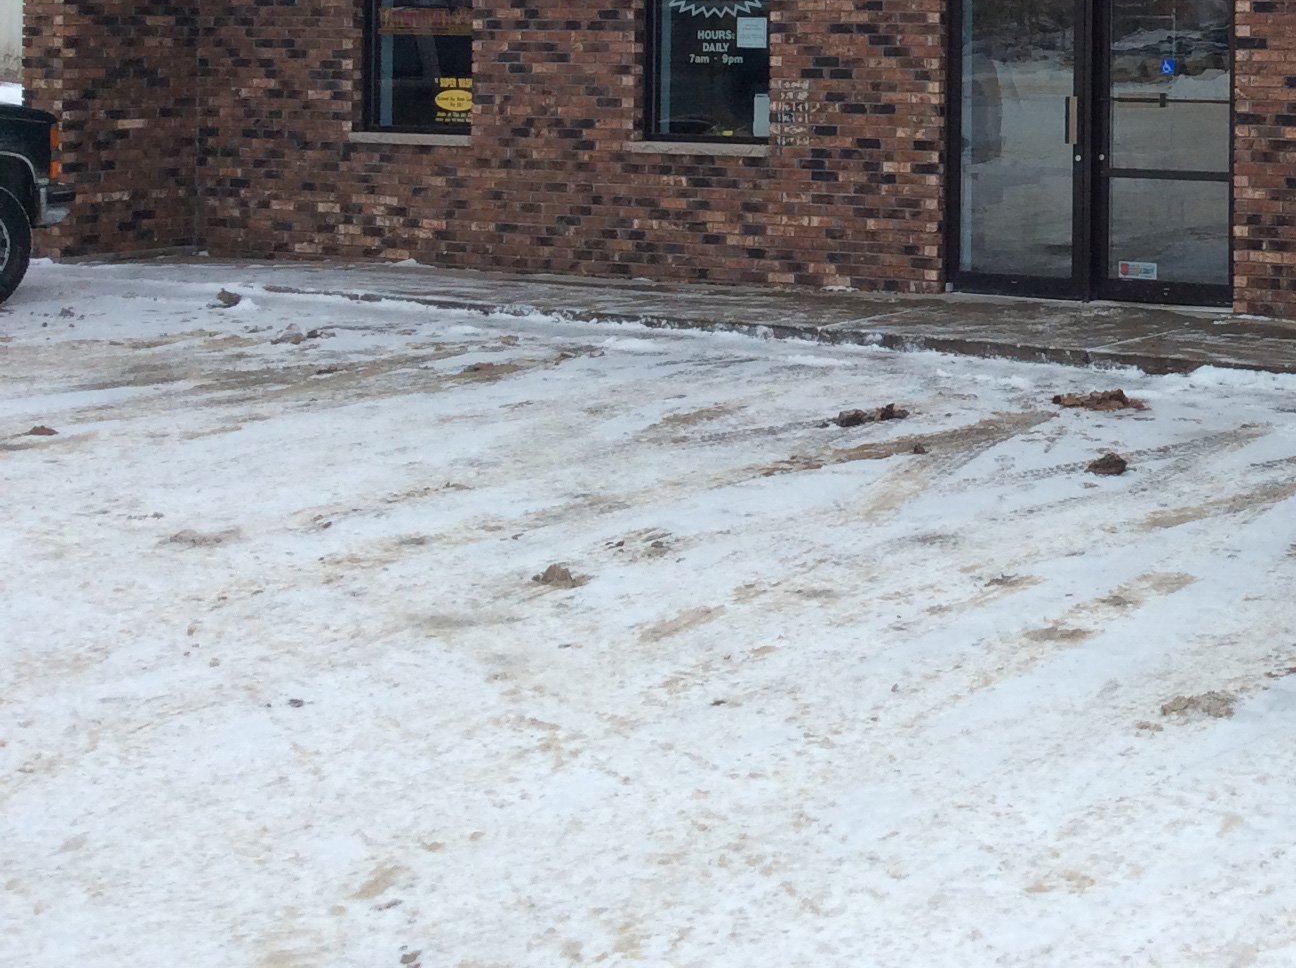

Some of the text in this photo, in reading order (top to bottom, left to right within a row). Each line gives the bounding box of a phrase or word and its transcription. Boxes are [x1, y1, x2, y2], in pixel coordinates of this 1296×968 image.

[697, 30, 735, 39] HOURS:
[702, 43, 729, 52] DAILY
[689, 54, 710, 63] 7am
[721, 54, 744, 65] 9pm
